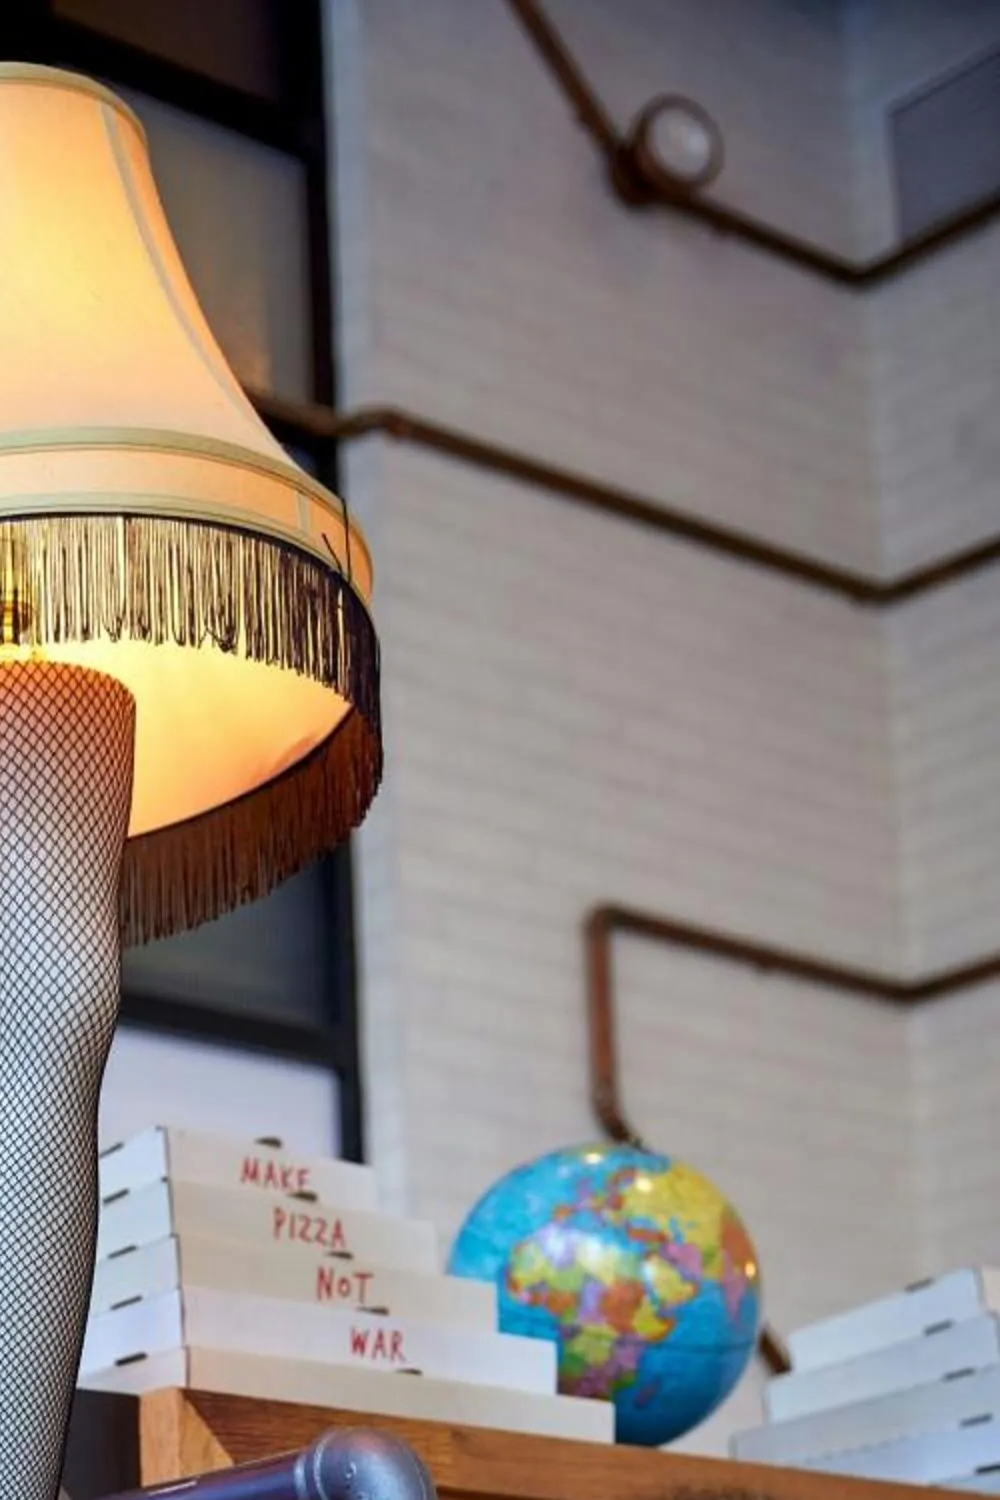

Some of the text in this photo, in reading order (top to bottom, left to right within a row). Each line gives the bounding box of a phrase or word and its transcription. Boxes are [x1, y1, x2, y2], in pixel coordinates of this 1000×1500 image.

[240, 1155, 311, 1192] MAKE
[272, 1206, 346, 1249] PIZZA
[349, 1327, 406, 1362] WAR
